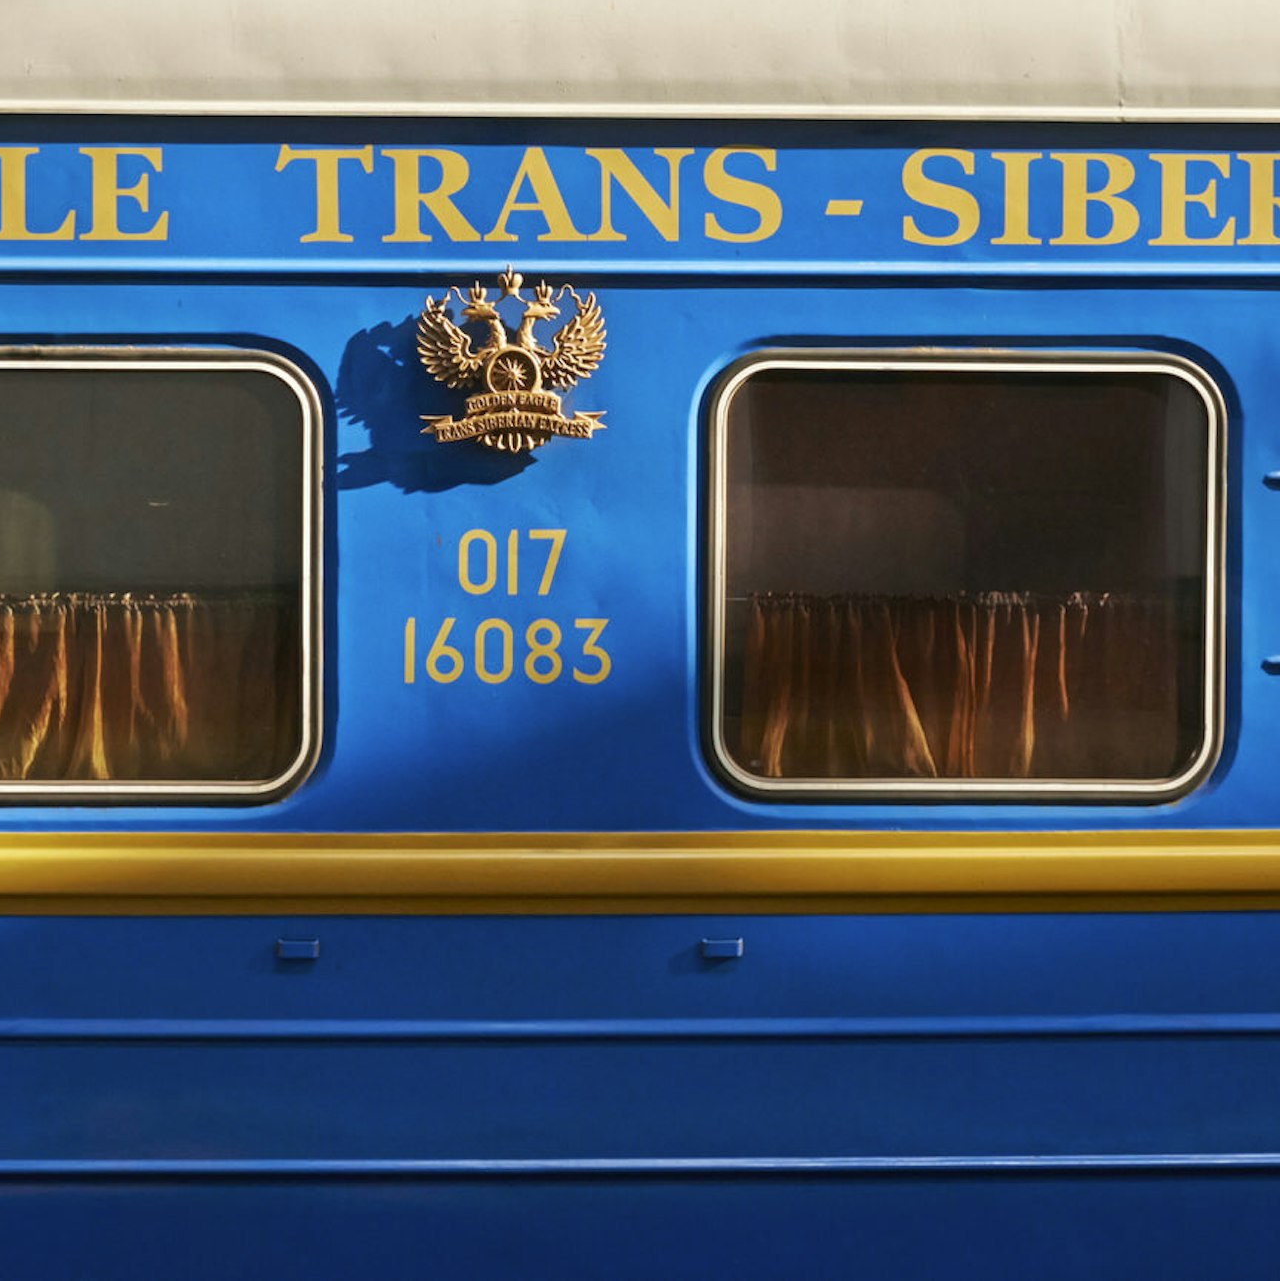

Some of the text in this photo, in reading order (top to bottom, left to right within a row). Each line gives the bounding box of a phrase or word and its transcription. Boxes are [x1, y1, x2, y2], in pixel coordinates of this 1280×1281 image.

[275, 142, 782, 244] TRANS
[436, 414, 590, 440] TRANS SIBERIAN EXPRESS
[467, 393, 558, 410] GOLDEN EAGLE
[458, 528, 568, 596] 017
[404, 616, 612, 685] 16083
